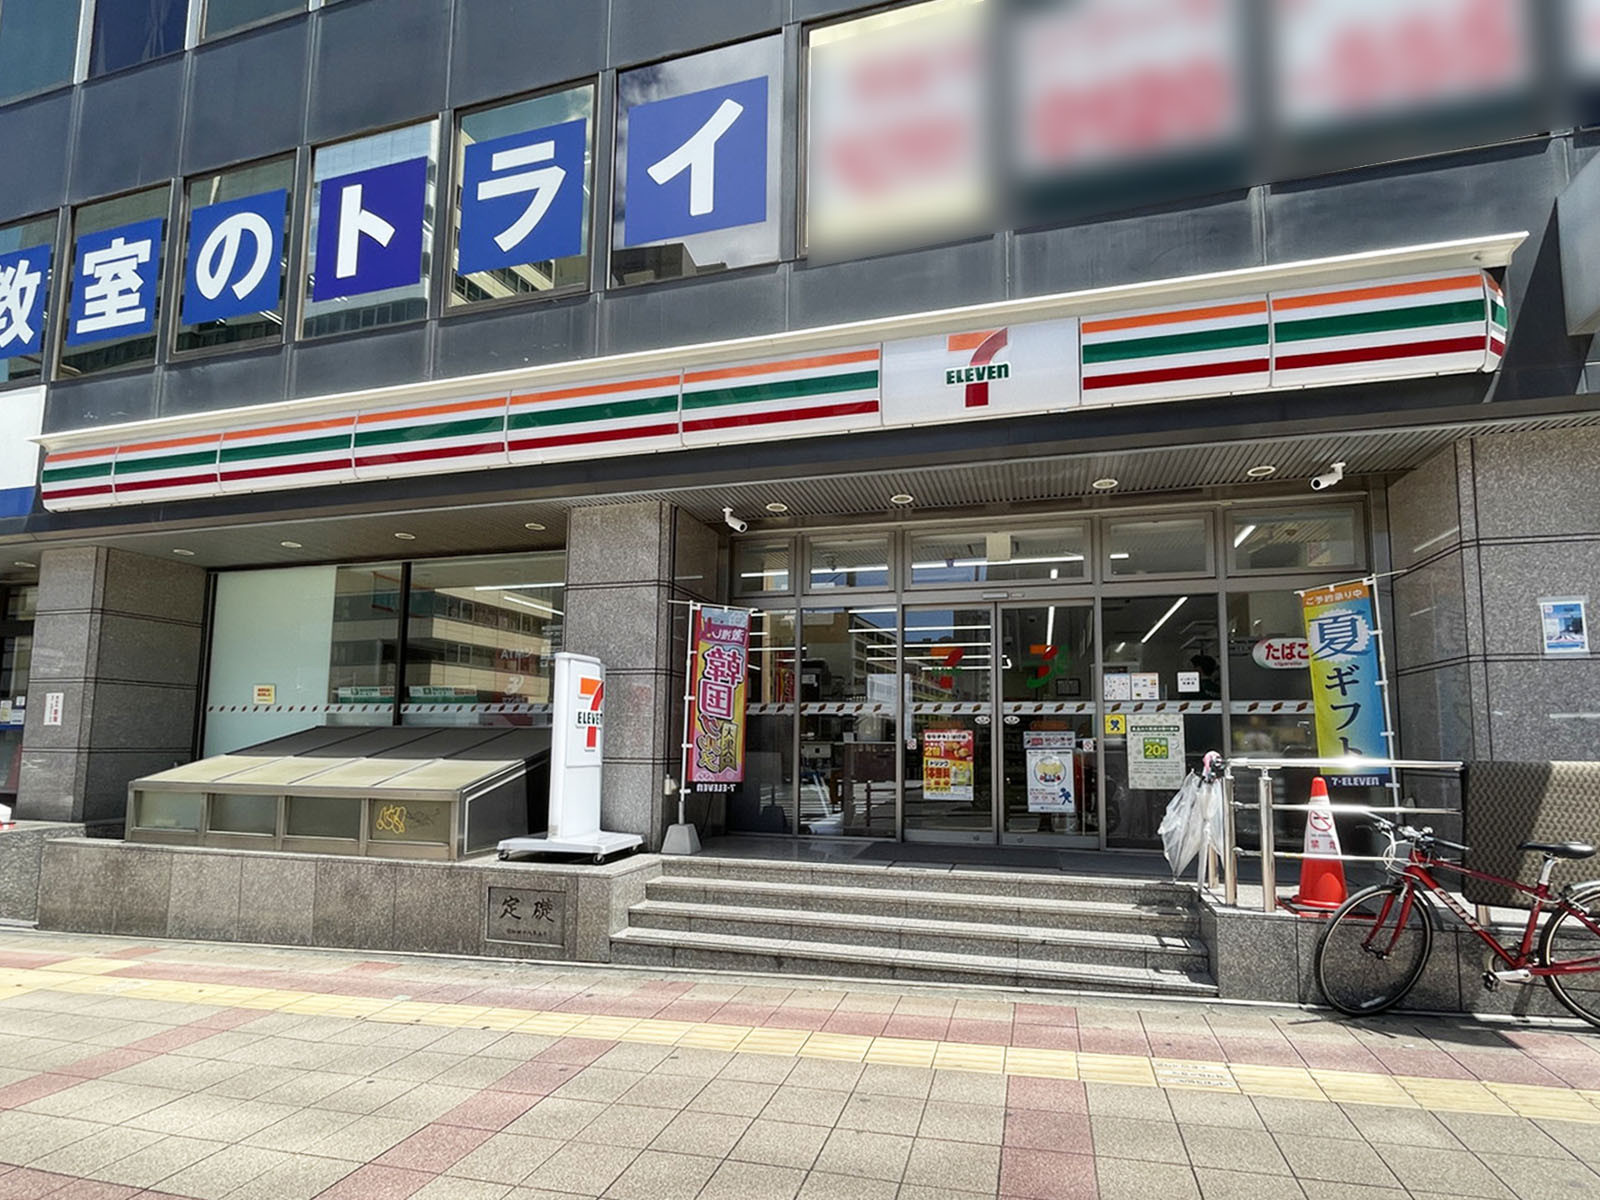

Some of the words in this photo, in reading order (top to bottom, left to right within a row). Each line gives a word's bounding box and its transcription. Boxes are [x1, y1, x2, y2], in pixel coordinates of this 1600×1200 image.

[0, 98, 743, 348] 教室のトライ
[1265, 642, 1309, 660] たばこ
[577, 711, 603, 725] ELEVE
